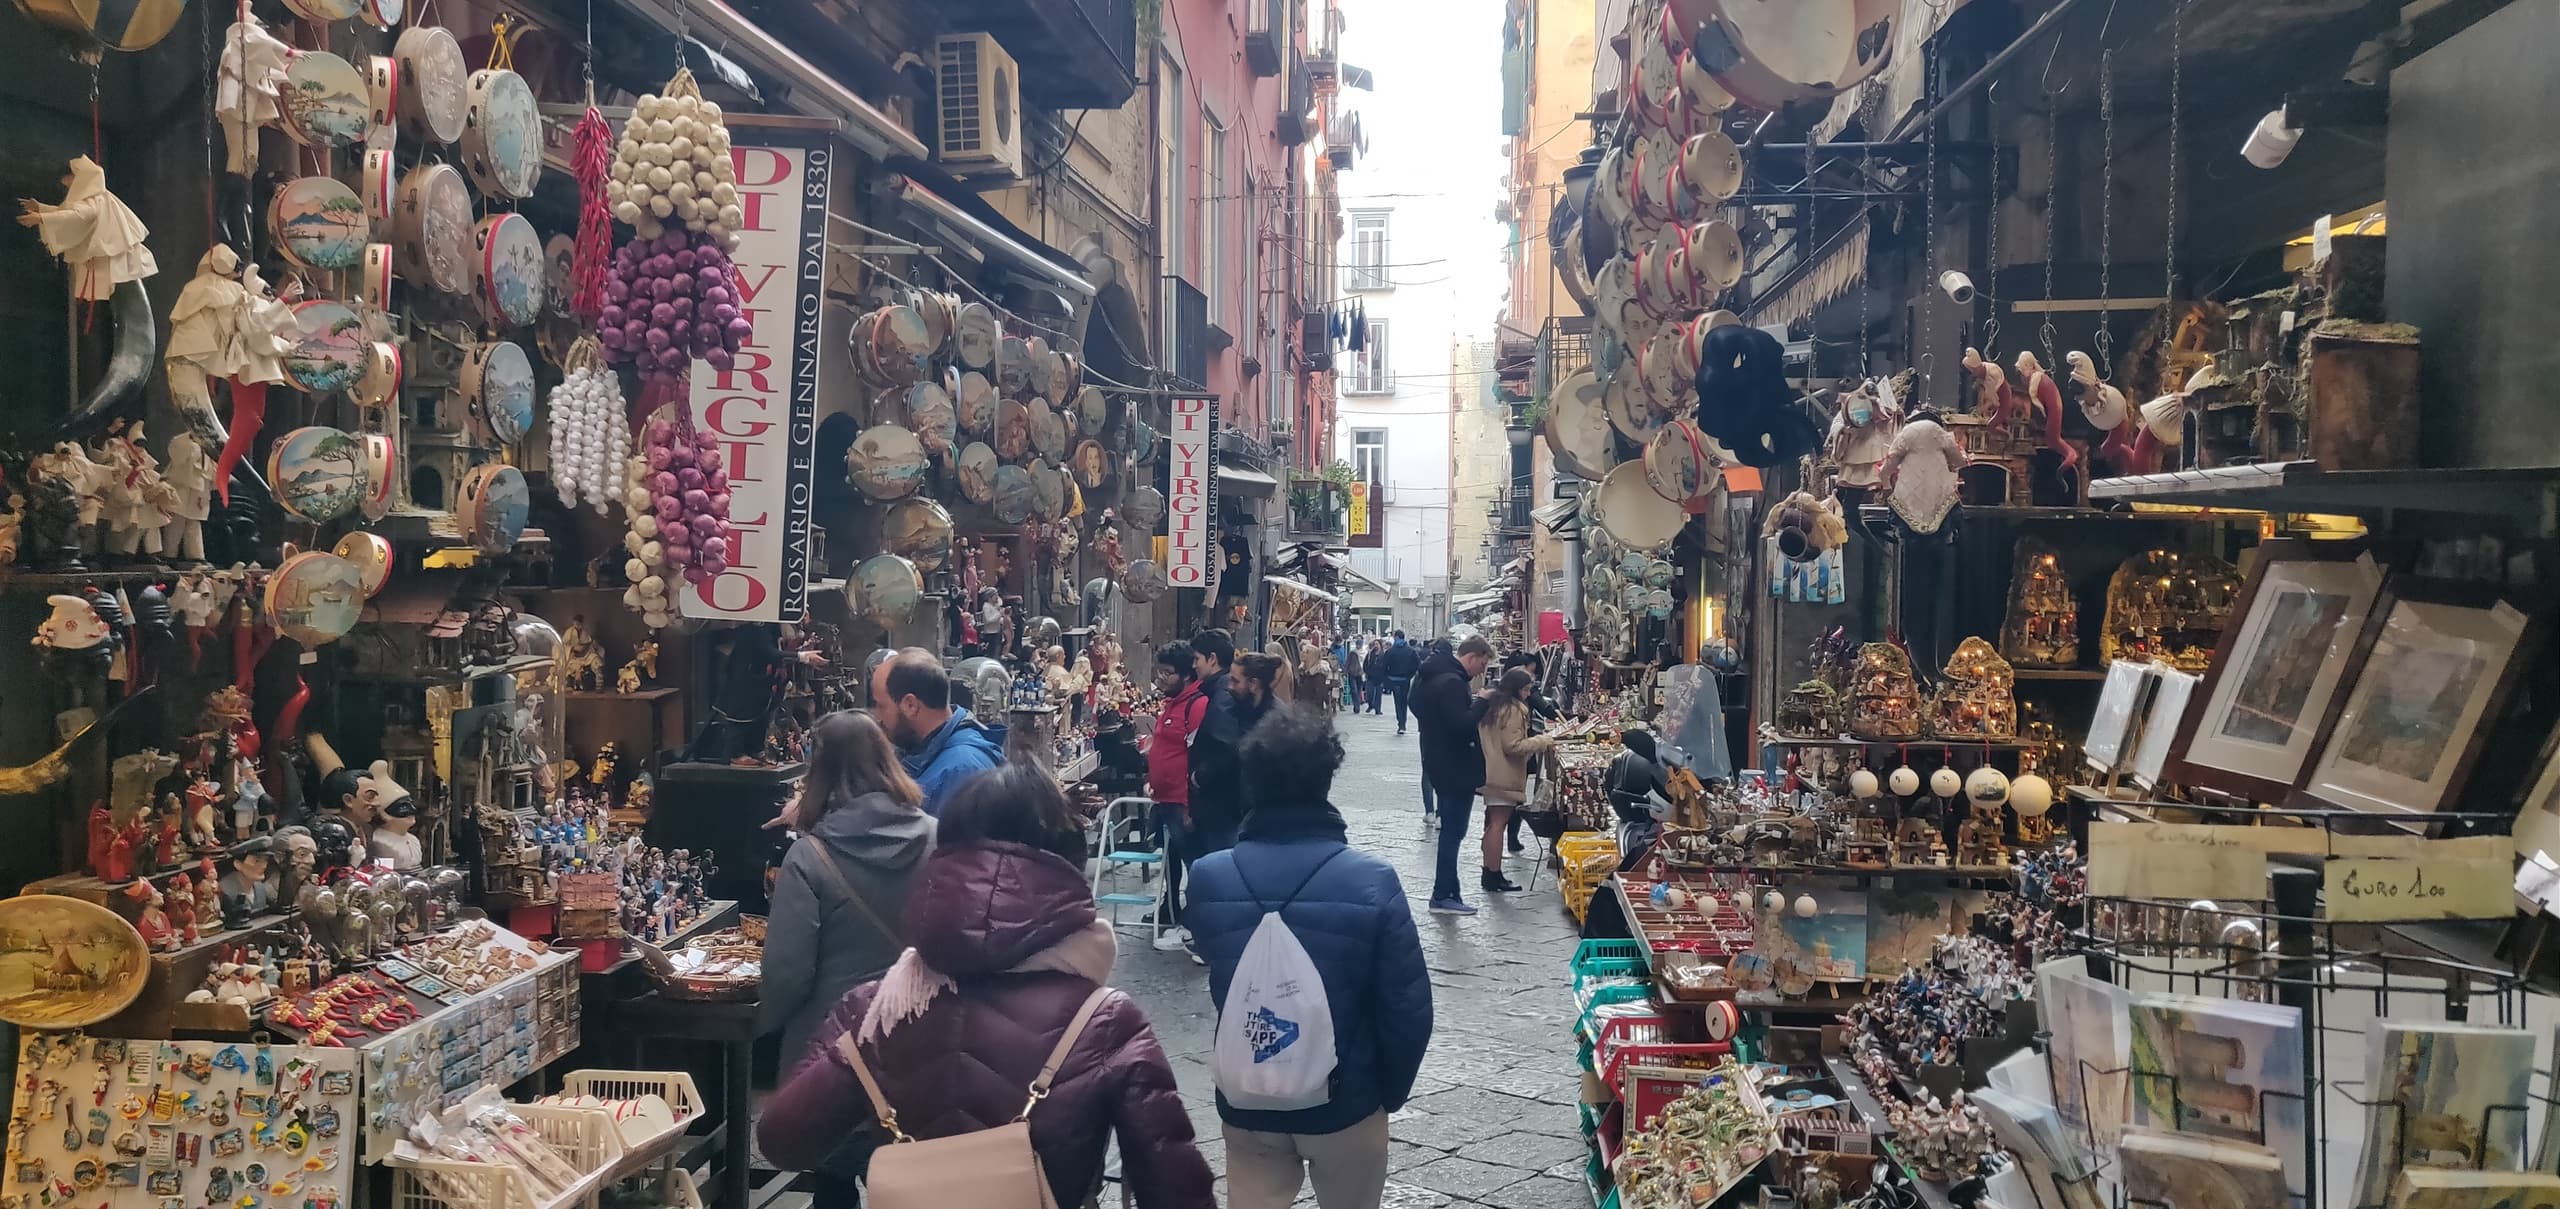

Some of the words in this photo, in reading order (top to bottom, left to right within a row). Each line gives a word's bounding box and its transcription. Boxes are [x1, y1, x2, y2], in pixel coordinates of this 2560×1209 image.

[731, 146, 792, 232] DI
[806, 149, 829, 212] 1830
[804, 224, 823, 282] DAL
[792, 293, 819, 446] GENNARO
[1175, 399, 1205, 431] DI
[794, 457, 810, 471] E
[1207, 454, 1218, 517] GENNARO
[1170, 443, 1204, 584] VIRGILIO
[784, 483, 810, 613] ROSARIO
[1206, 530, 1218, 583] ROSARIO
